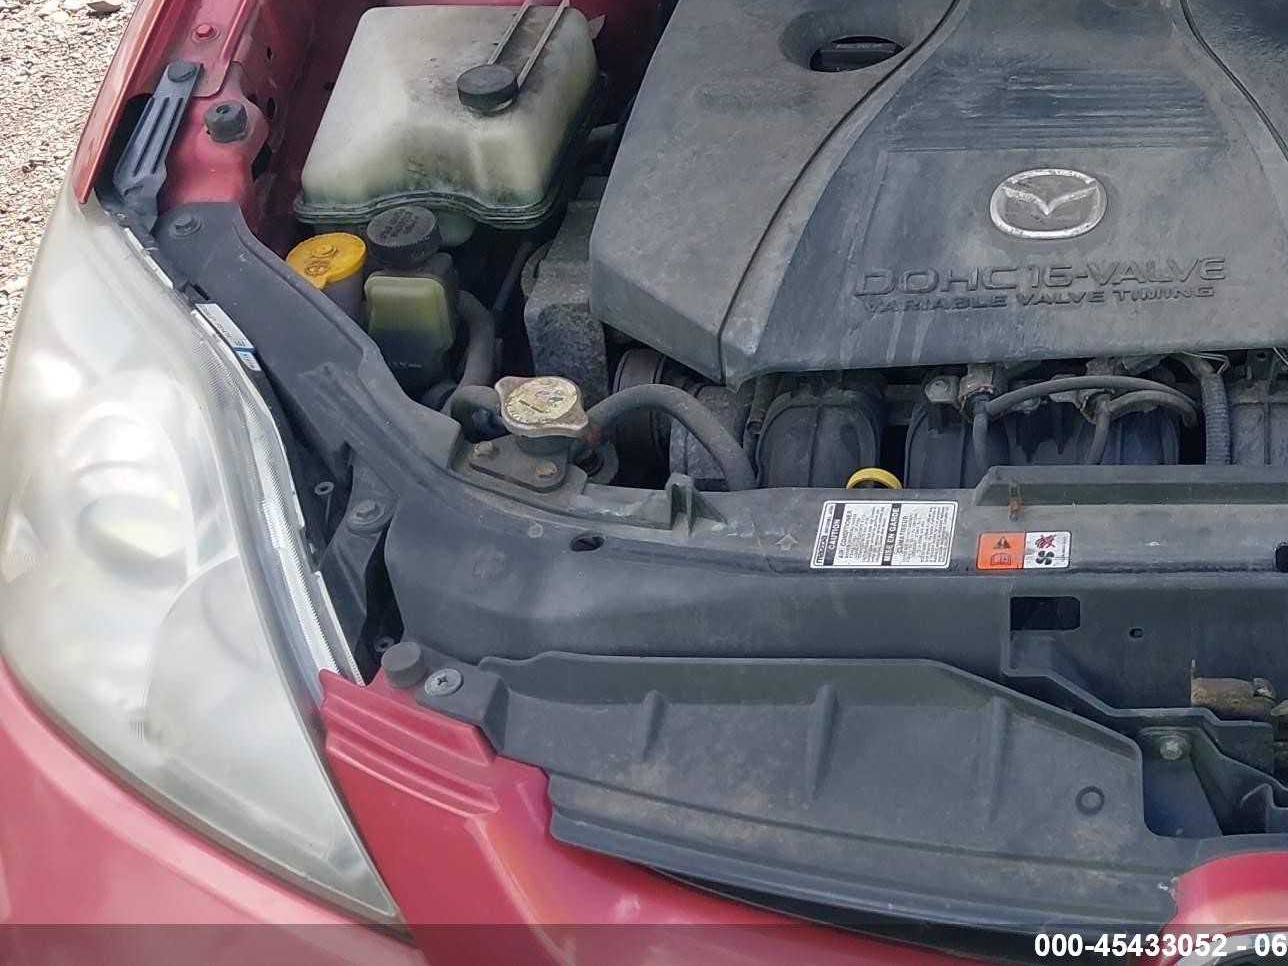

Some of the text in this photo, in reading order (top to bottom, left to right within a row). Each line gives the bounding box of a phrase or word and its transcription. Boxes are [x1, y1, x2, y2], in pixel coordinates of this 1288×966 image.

[855, 266, 1018, 297] DOHC
[863, 286, 1216, 314] VARIABLE VALVE TIMING
[828, 518, 841, 550] CAUTION
[839, 510, 853, 547] CONDITIONER
[884, 507, 900, 562] MISE EN GARDE
[896, 515, 909, 554] CLIMATISEUR
